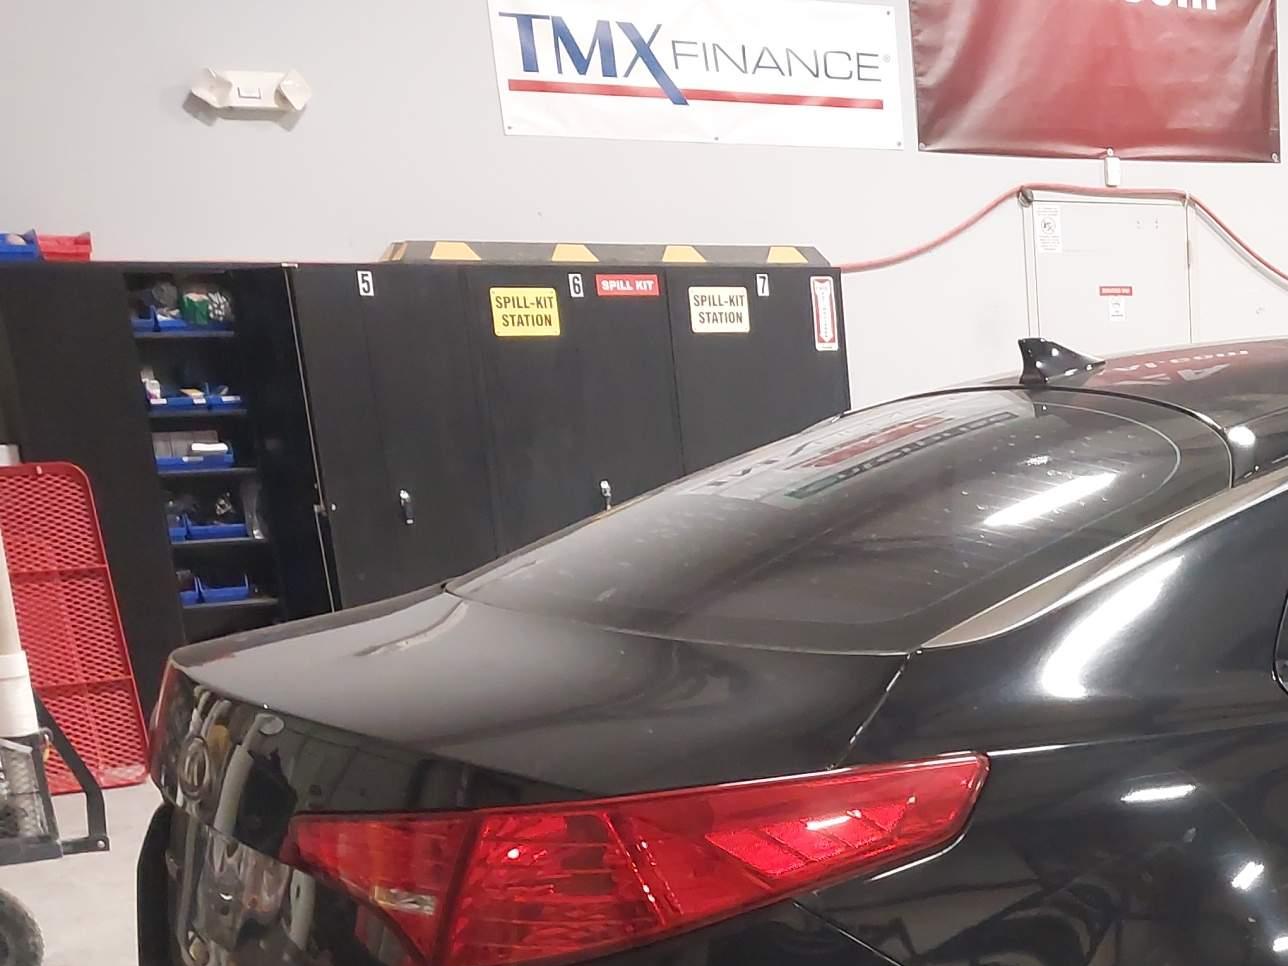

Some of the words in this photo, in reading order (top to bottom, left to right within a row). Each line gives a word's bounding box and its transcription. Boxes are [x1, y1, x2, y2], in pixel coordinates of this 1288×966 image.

[499, 12, 689, 106] TMX
[361, 273, 370, 294] 5
[572, 276, 581, 295] 6
[601, 280, 633, 291] SPILL
[636, 280, 655, 291] KIT
[758, 276, 767, 294] 7
[495, 296, 554, 309] SPILL-KIT
[693, 295, 745, 307] SPILL-KIT
[502, 314, 552, 327] STATION
[698, 312, 743, 324] STATION
